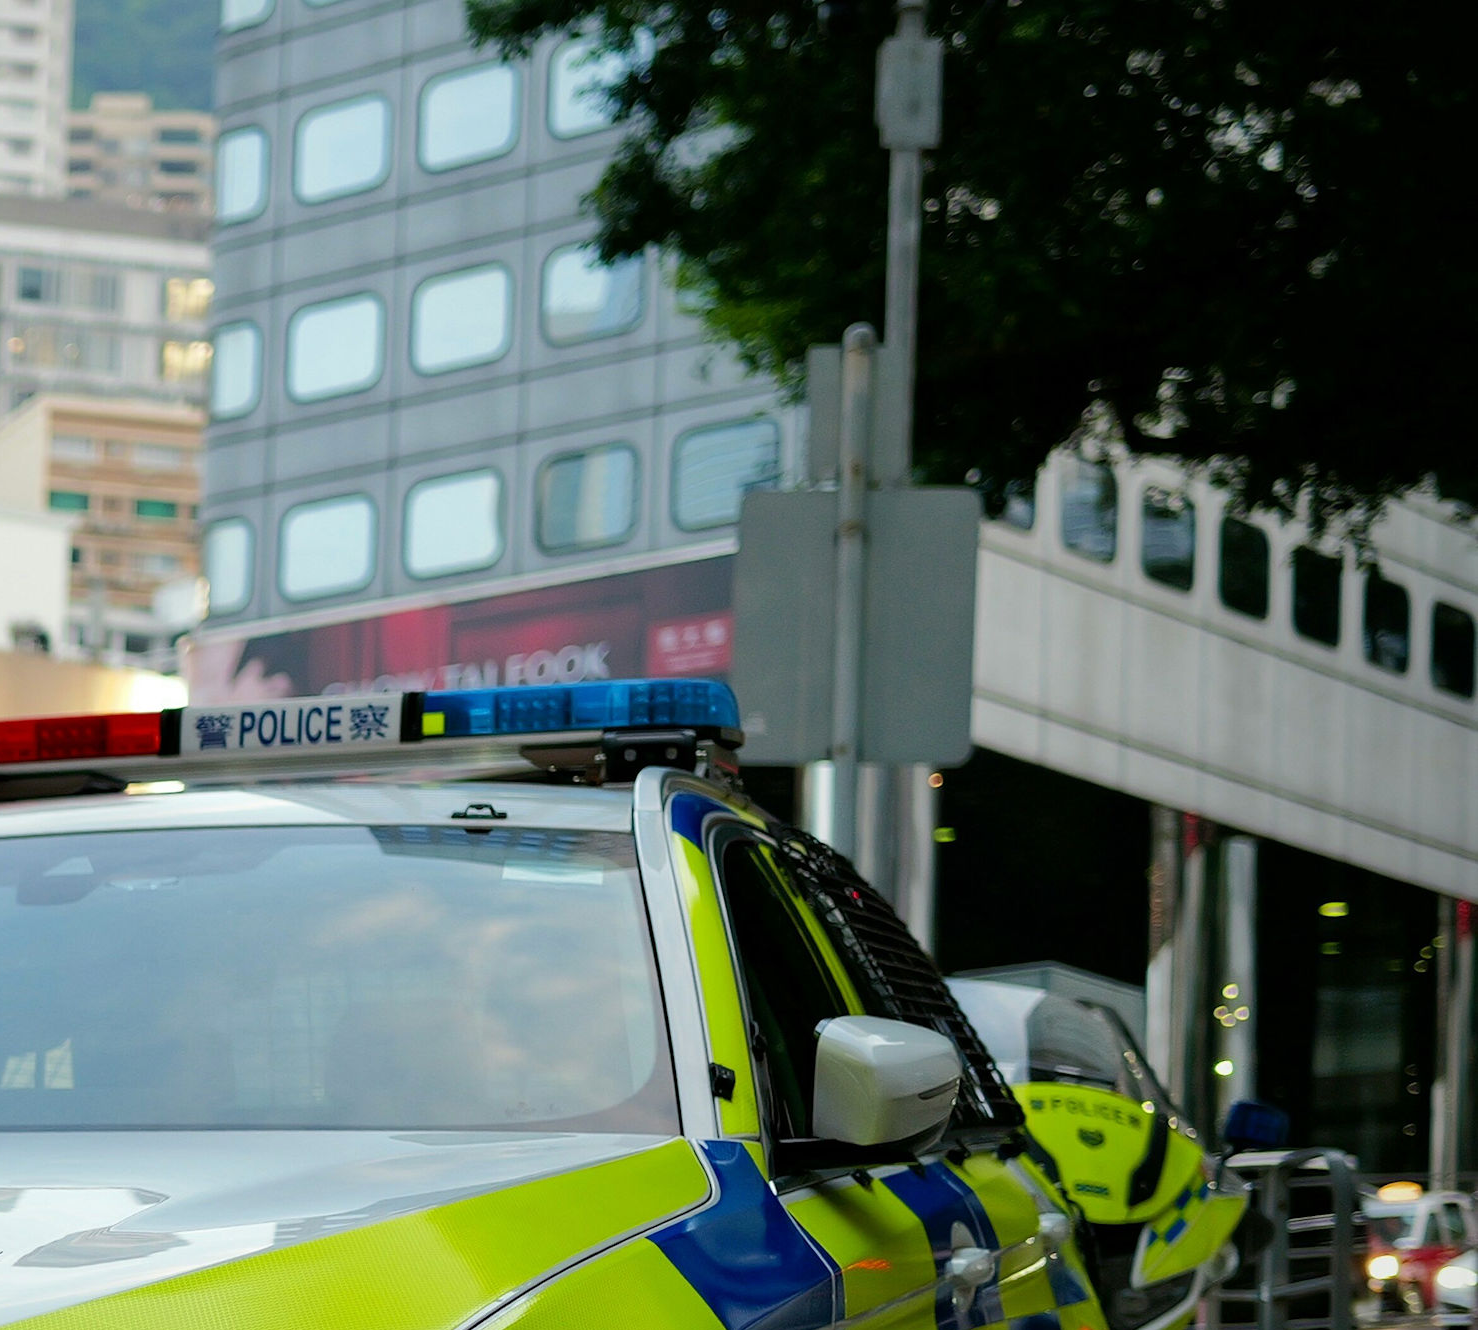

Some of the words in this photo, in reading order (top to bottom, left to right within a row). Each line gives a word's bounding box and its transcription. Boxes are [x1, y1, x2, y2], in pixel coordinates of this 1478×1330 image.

[504, 641, 610, 689] FOOK
[239, 705, 344, 748] POLICE
[349, 704, 390, 741] 察
